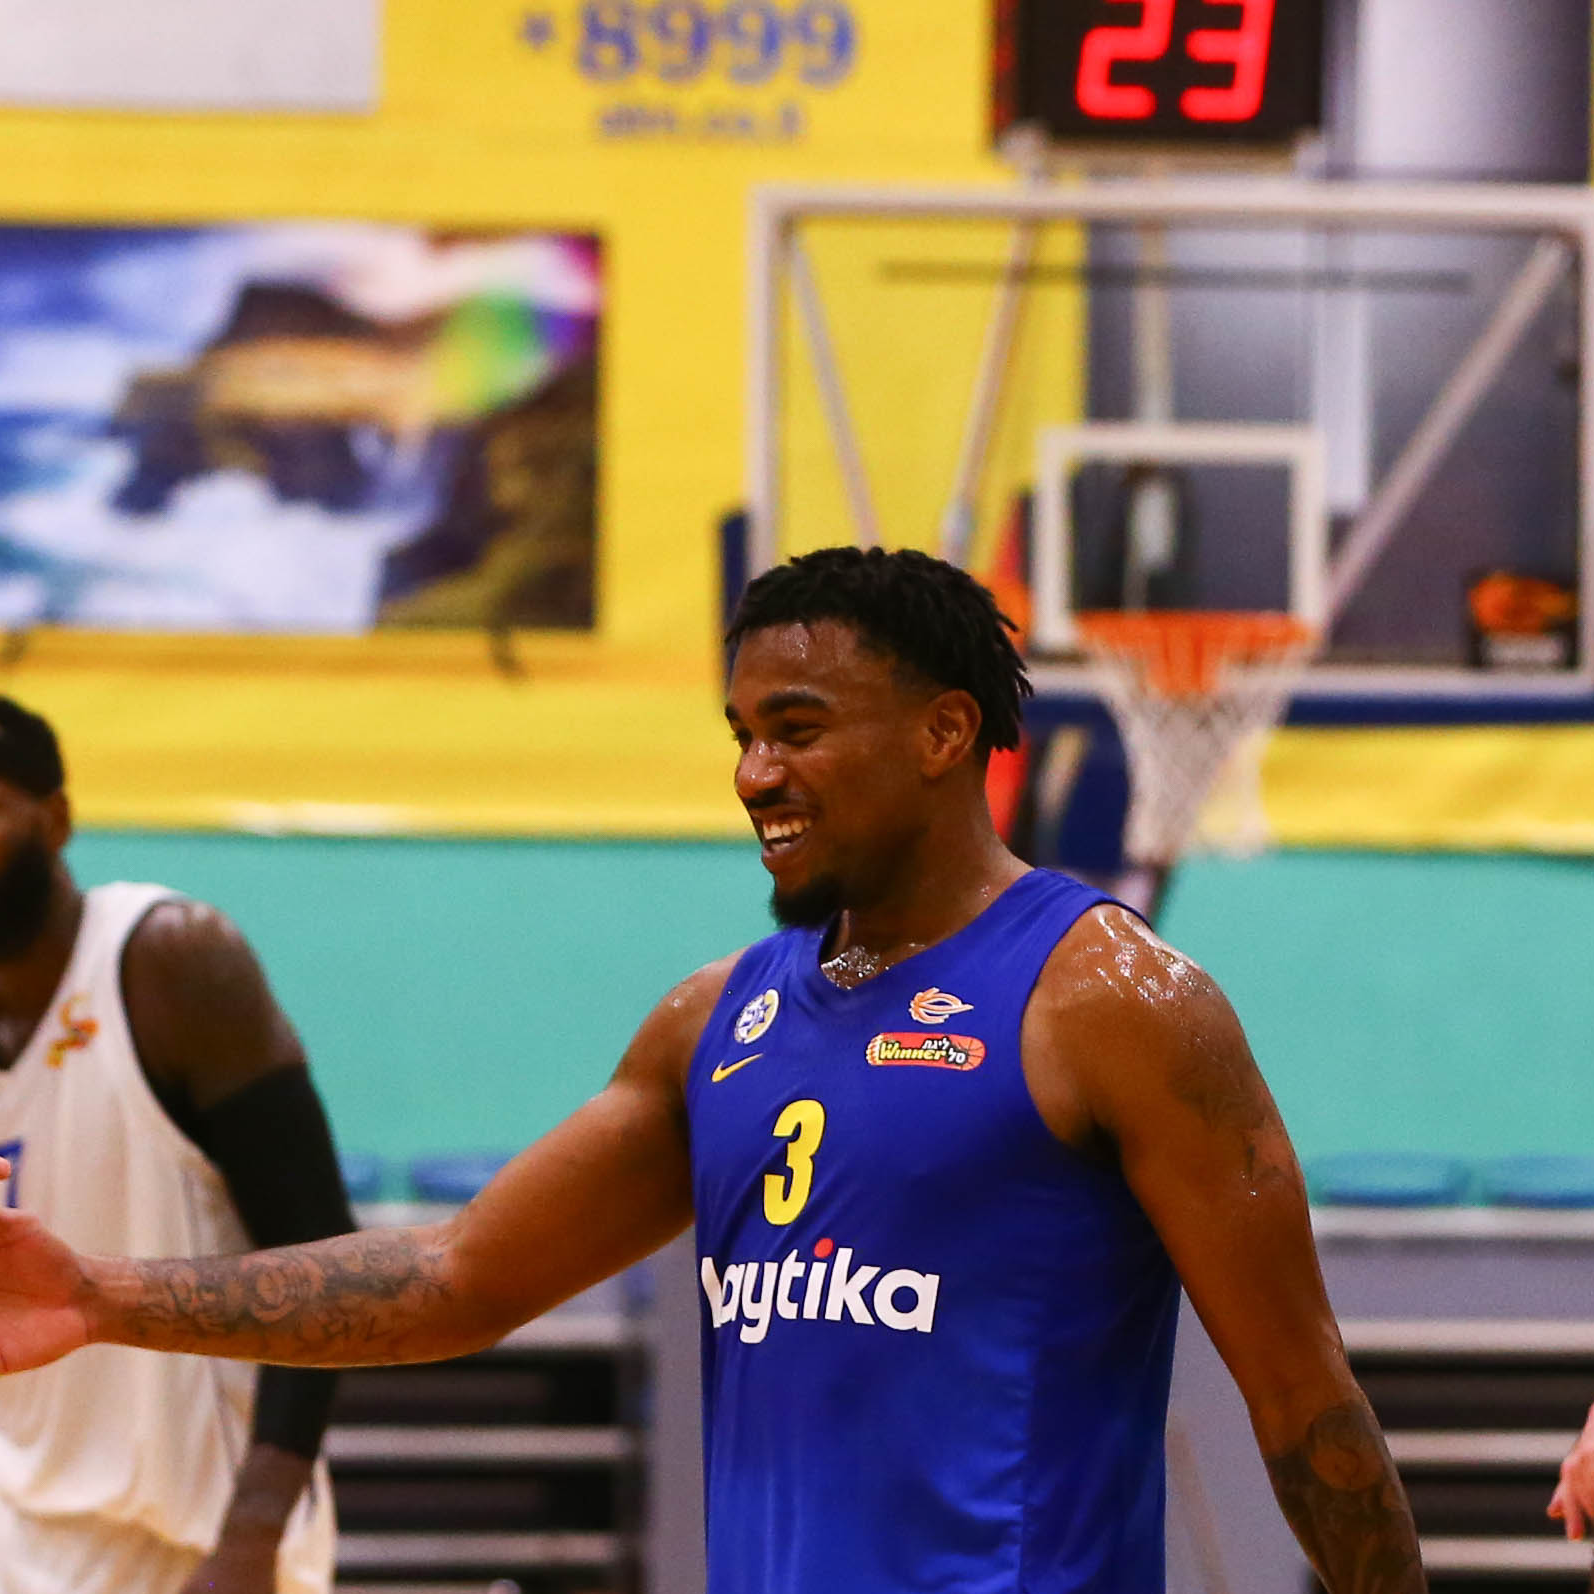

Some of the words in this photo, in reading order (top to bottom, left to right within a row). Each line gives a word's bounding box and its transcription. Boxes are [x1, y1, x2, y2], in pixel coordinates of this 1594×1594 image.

[1075, 0, 1275, 121] 23
[879, 1042, 946, 1060] Winner
[763, 1098, 825, 1225] 3
